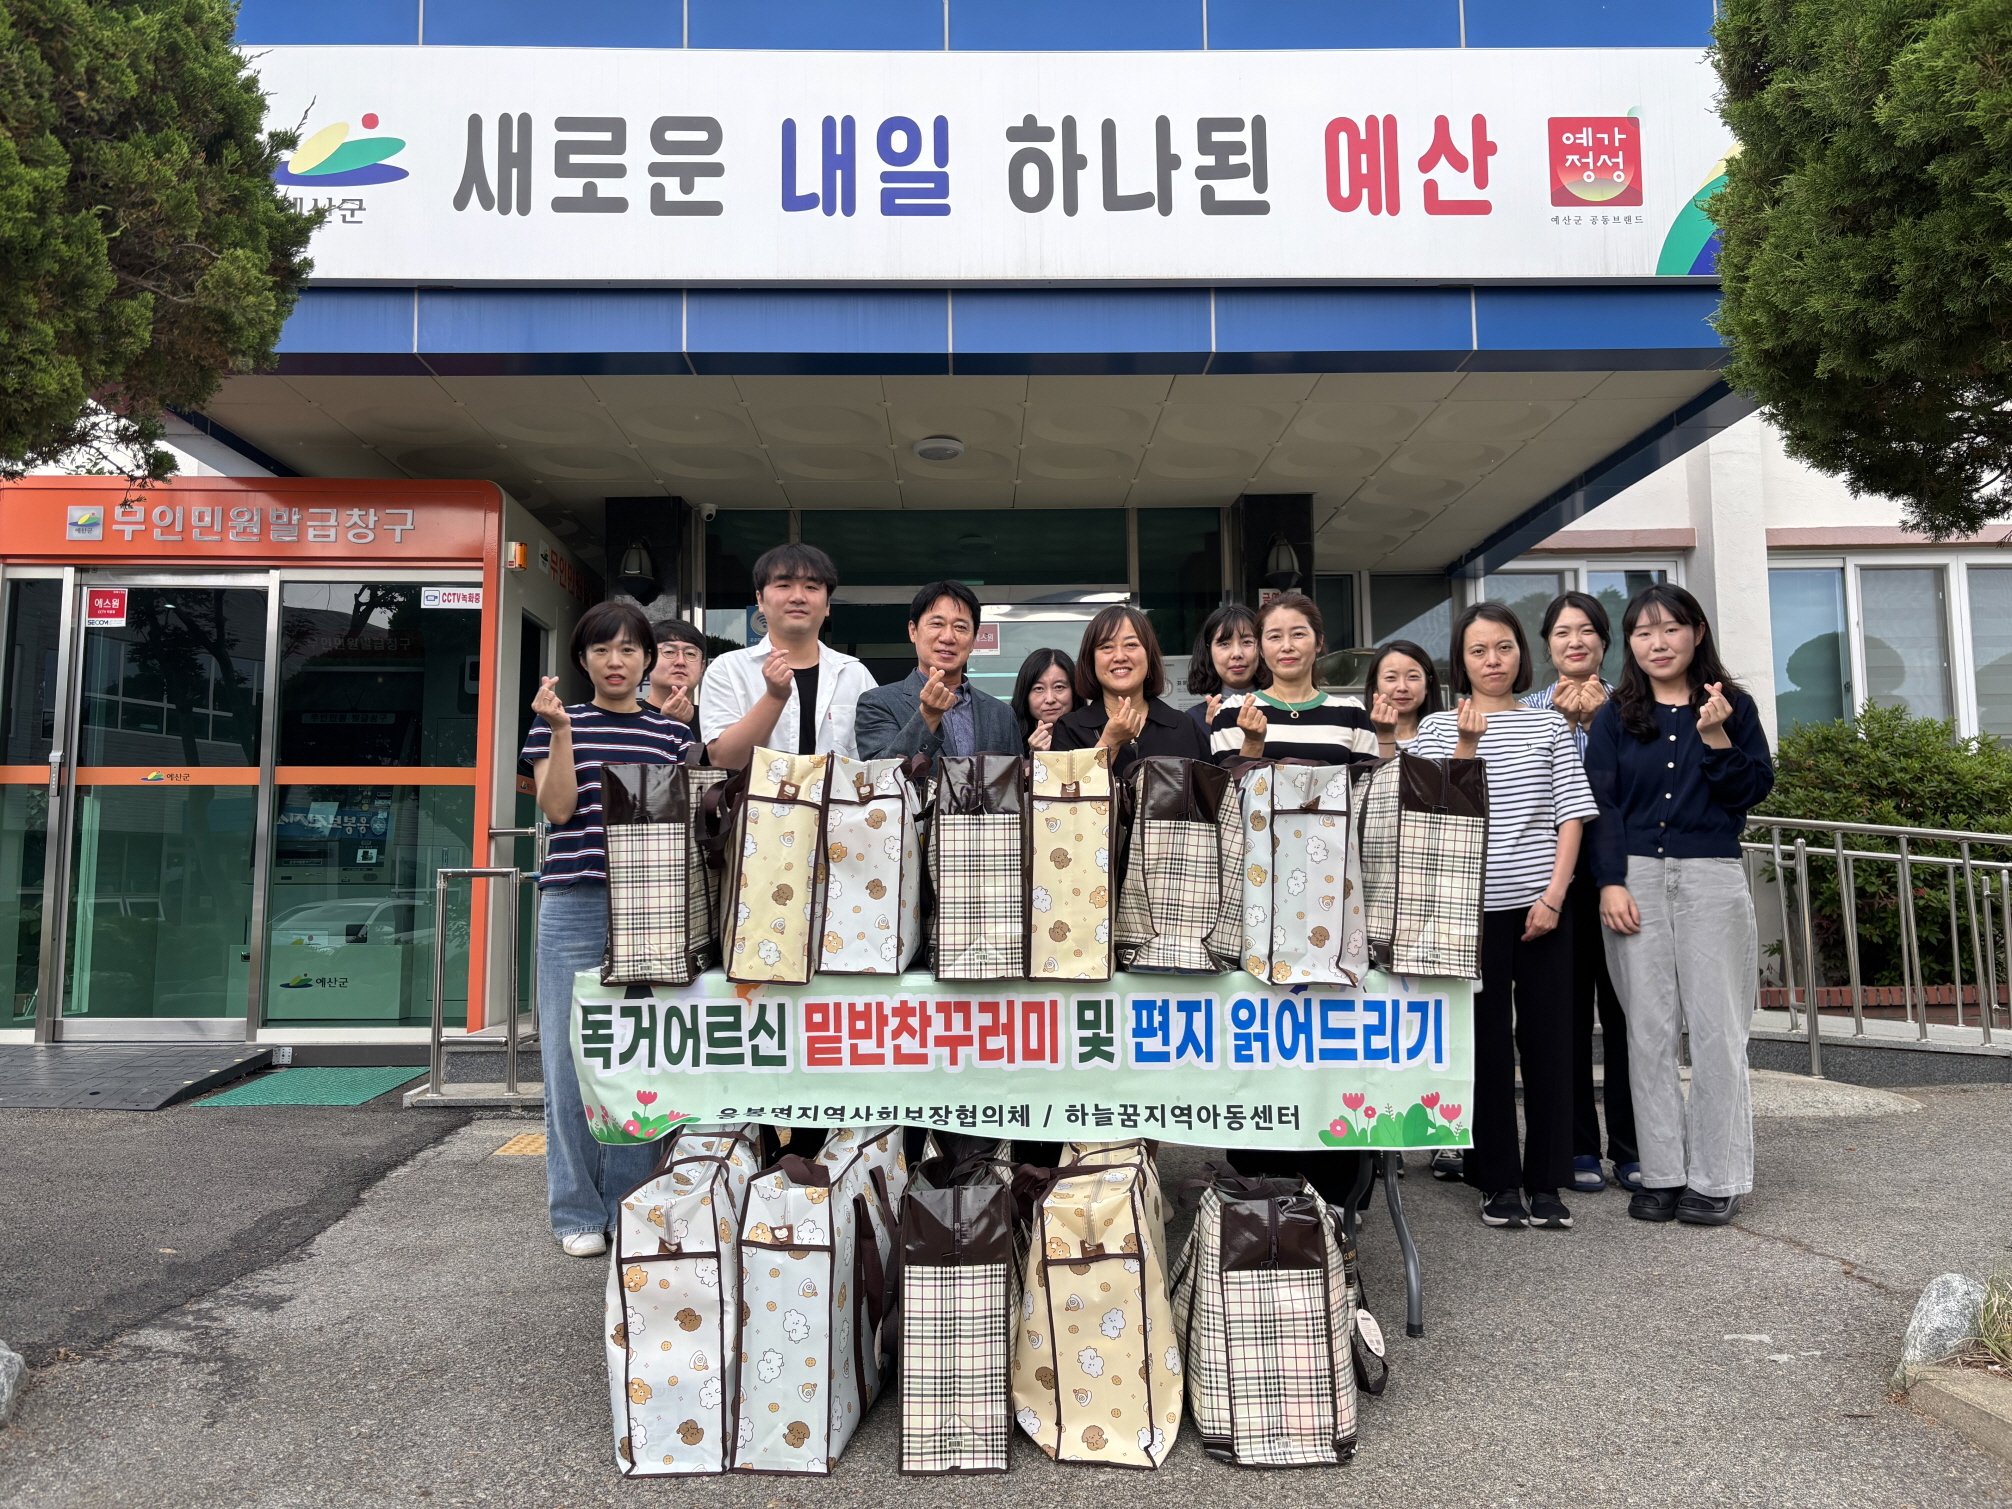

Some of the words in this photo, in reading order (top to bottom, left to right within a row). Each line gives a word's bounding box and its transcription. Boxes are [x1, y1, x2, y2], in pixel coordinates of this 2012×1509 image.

[1562, 127, 1626, 147] 예가
[452, 112, 725, 218] 새로운
[781, 114, 951, 218] 내일
[1005, 113, 1271, 217] 하나된
[1324, 113, 1498, 217] 예산
[1564, 150, 1626, 183] 정성
[1550, 215, 1583, 226] 예산군
[1589, 215, 1644, 226] 공동브랜드
[112, 504, 416, 545] 무인민원발급창구
[94, 598, 119, 608] 에스원
[441, 592, 481, 604] CCTV녹화중
[315, 976, 349, 988] 예산군
[581, 1001, 788, 1070] 독거어르신
[804, 998, 1059, 1067] 밑반찬꾸러미
[1076, 998, 1116, 1064] 및
[1131, 998, 1214, 1063] 편지
[1230, 997, 1443, 1065] 읽어드리기
[1065, 1103, 1301, 1131] 하늘꿈지역아동센터
